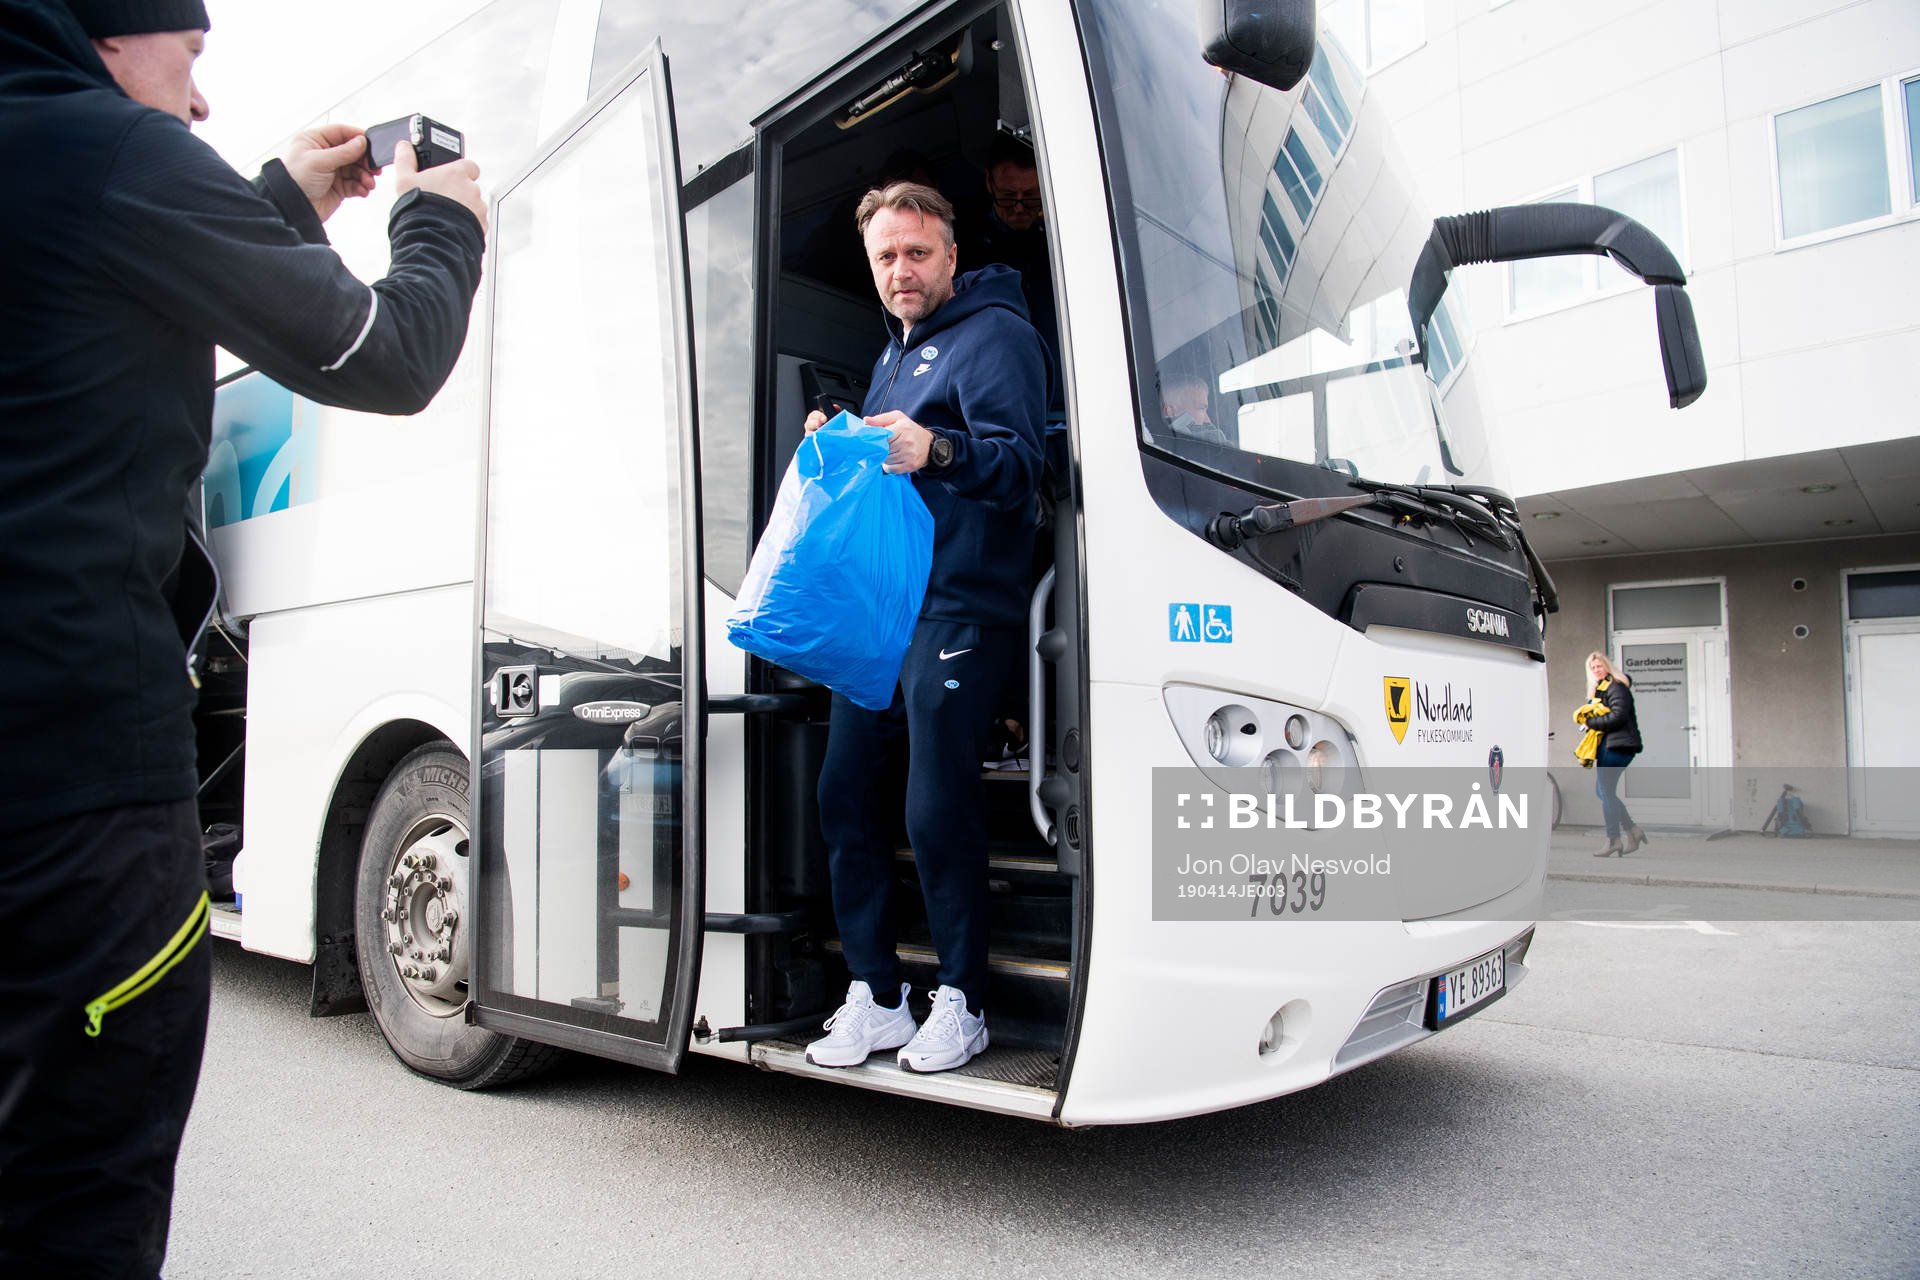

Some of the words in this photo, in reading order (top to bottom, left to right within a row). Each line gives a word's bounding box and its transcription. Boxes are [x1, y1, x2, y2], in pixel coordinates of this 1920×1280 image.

[1466, 608, 1510, 638] SCANIA
[1626, 657, 1684, 667] Garderober
[582, 706, 641, 720] OmniExpress
[1416, 680, 1472, 722] Nordland
[1418, 729, 1473, 742] FYLKESKOMMUNE
[423, 767, 470, 795] MICHE
[1249, 868, 1326, 917] 7039
[1450, 972, 1466, 1009] YE
[1472, 954, 1502, 999] 89363
